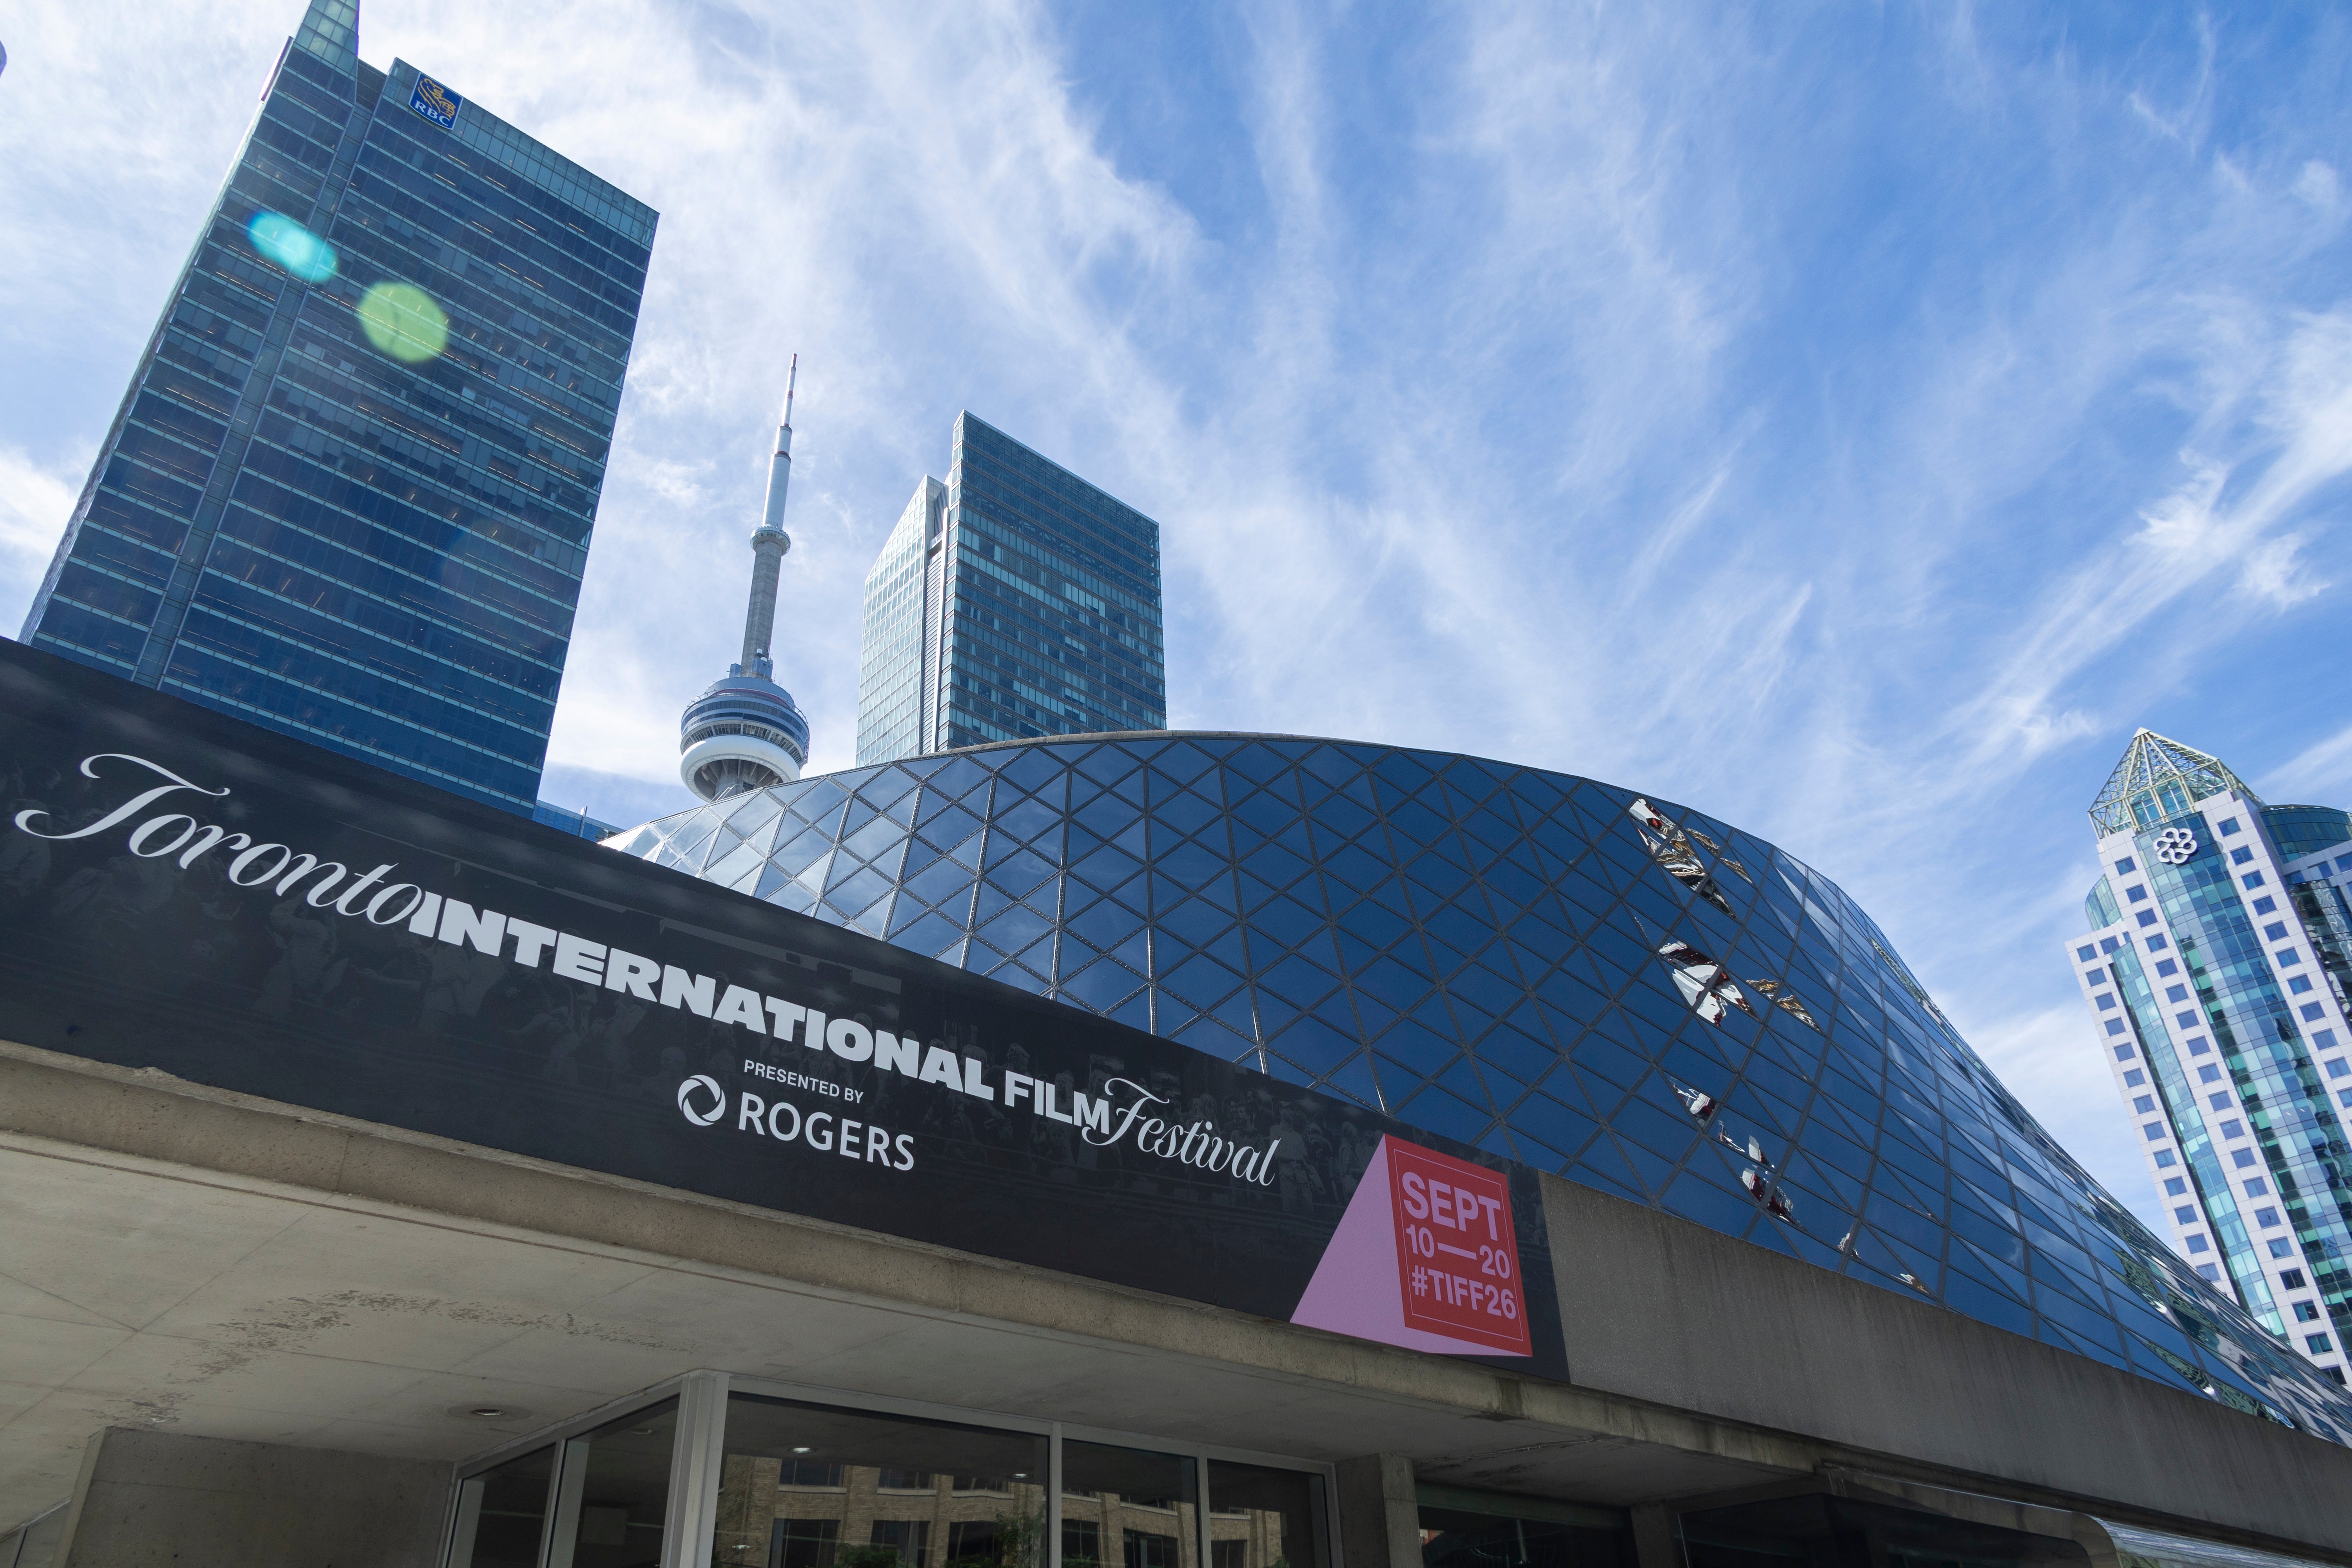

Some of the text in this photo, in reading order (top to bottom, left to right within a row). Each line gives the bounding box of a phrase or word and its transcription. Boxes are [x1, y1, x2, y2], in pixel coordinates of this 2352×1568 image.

[415, 100, 450, 126] RBC
[15, 753, 1281, 1186] Toronto INTERNATIONAL FILM Festival
[744, 1059, 864, 1103] PRESENTED BY
[739, 1092, 914, 1171] ROGERS
[1402, 1172, 1501, 1241] SEPT
[1412, 1265, 1516, 1319] #TIFF26
